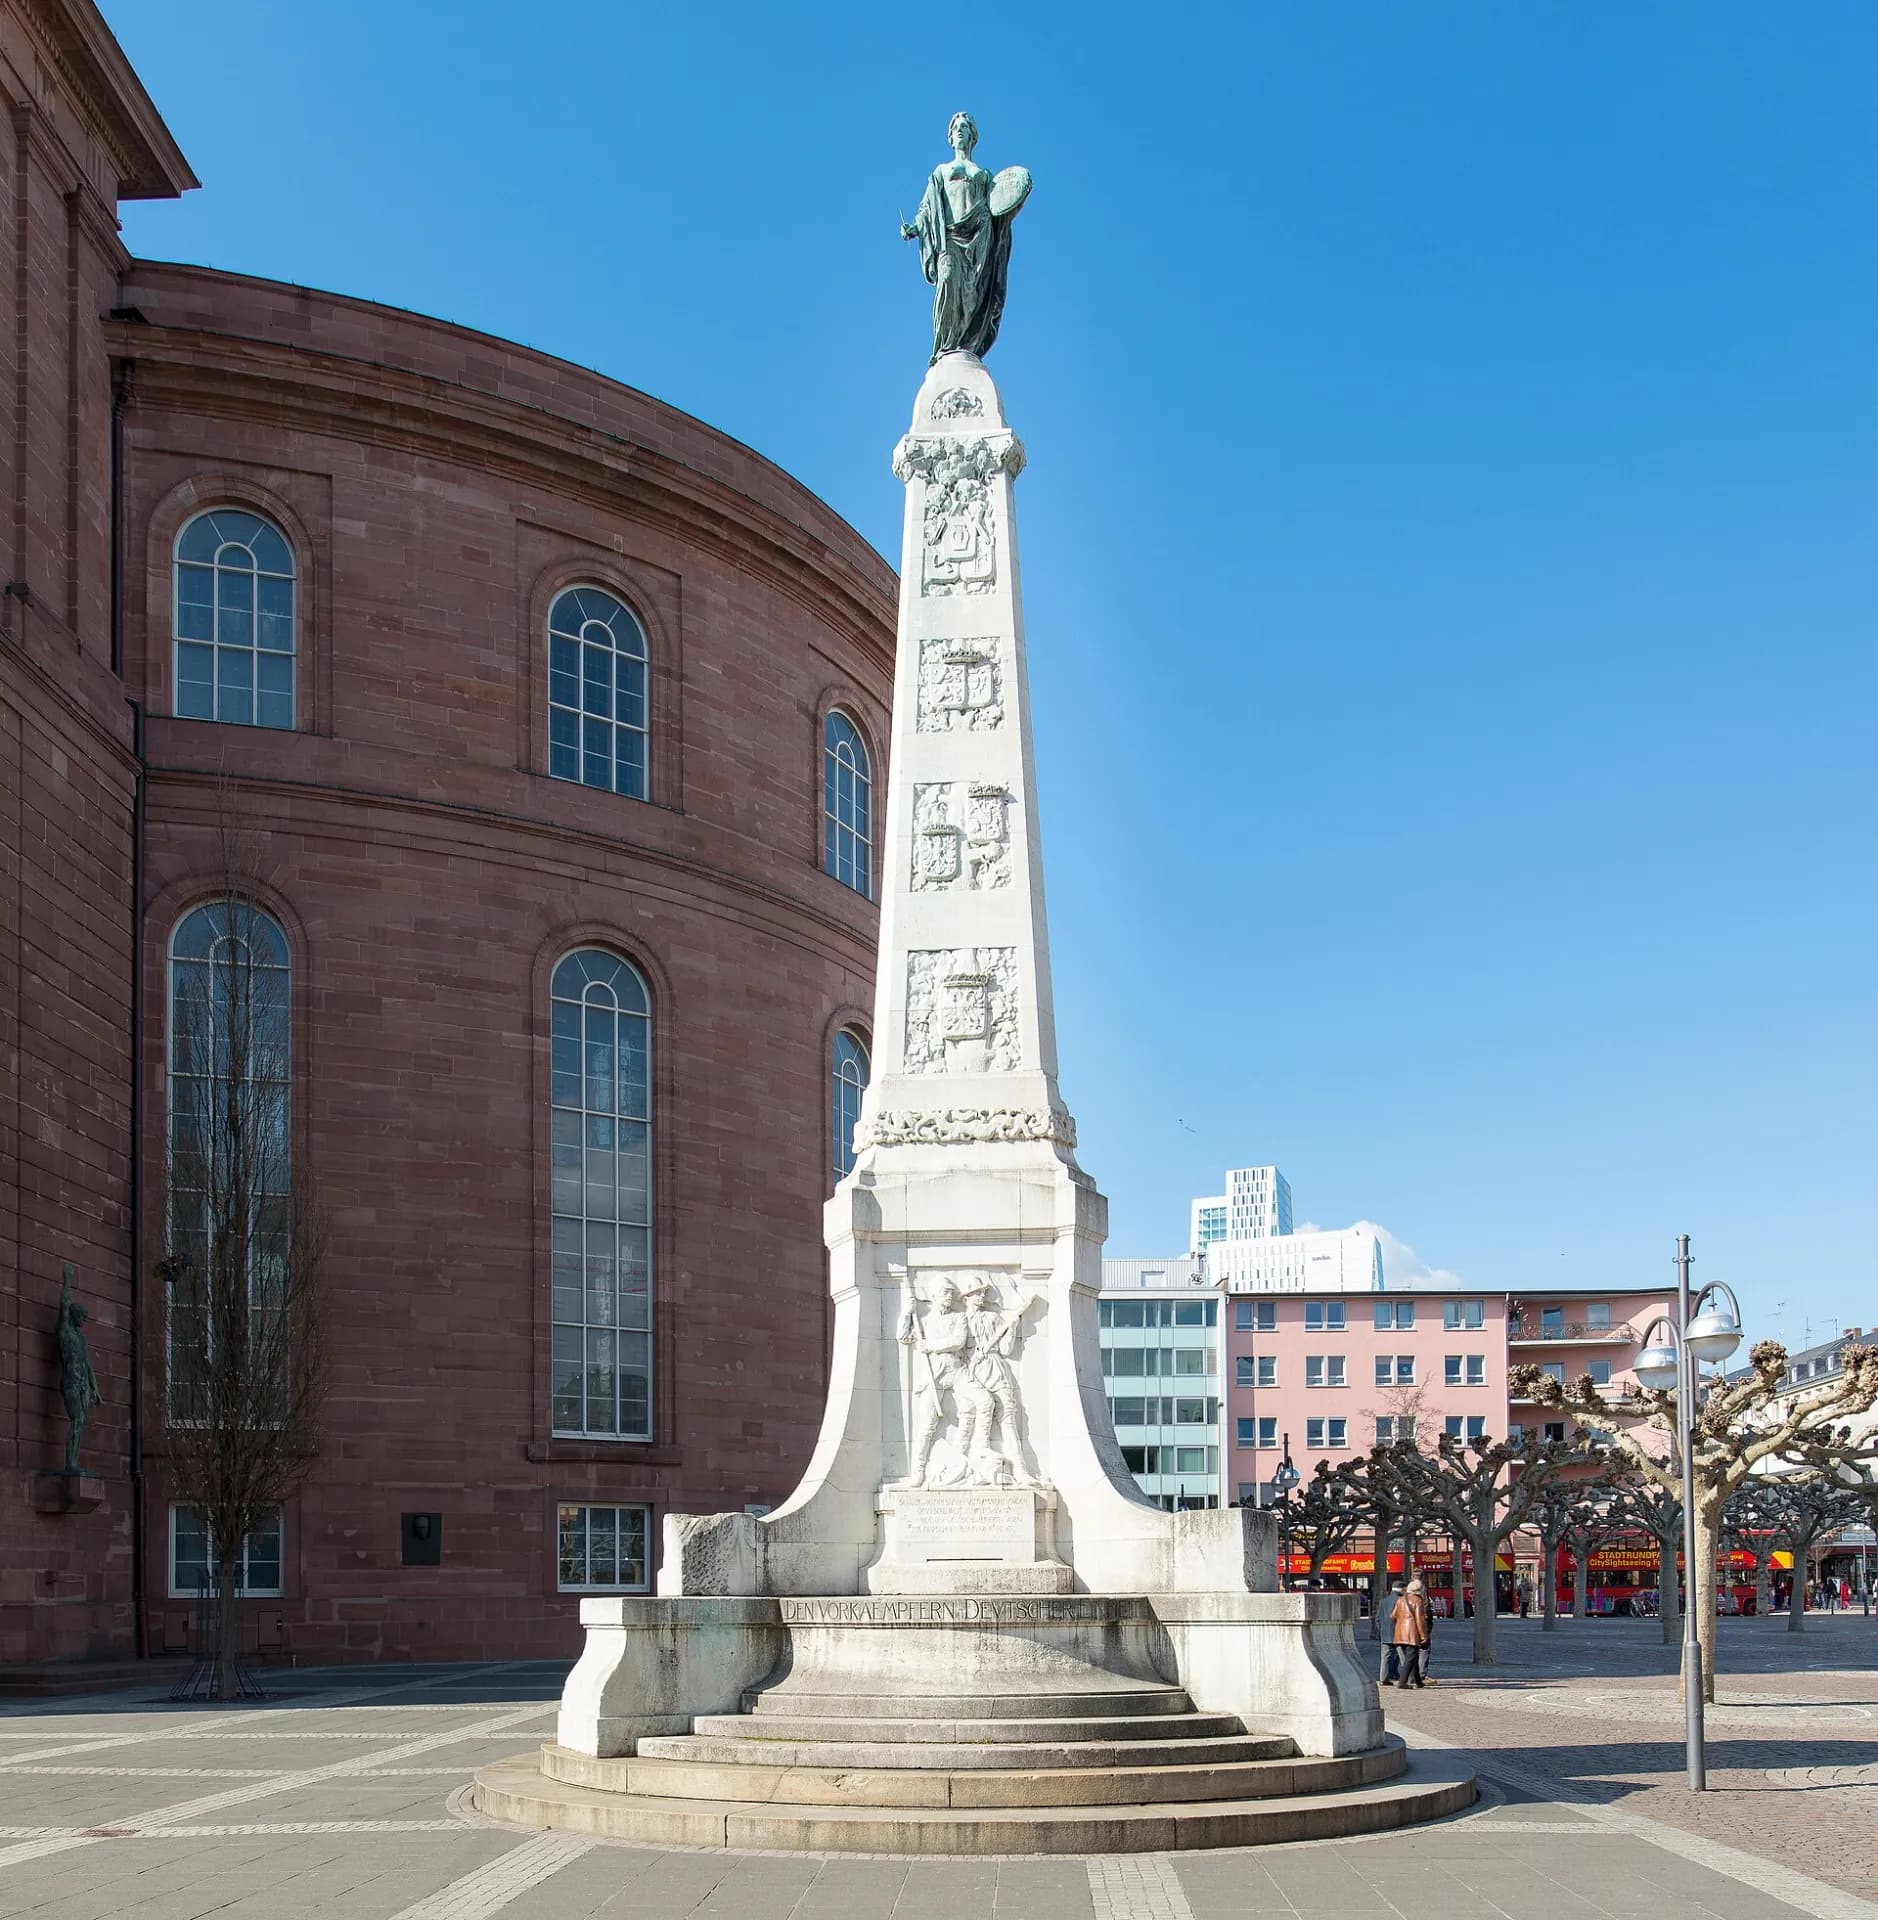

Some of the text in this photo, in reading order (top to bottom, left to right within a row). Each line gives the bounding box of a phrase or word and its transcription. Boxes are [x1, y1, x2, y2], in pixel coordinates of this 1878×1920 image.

[1589, 1559, 1650, 1567] CitySightseeing
[786, 1600, 814, 1620] DEN
[817, 1601, 955, 1620] VORKAEMPFERN
